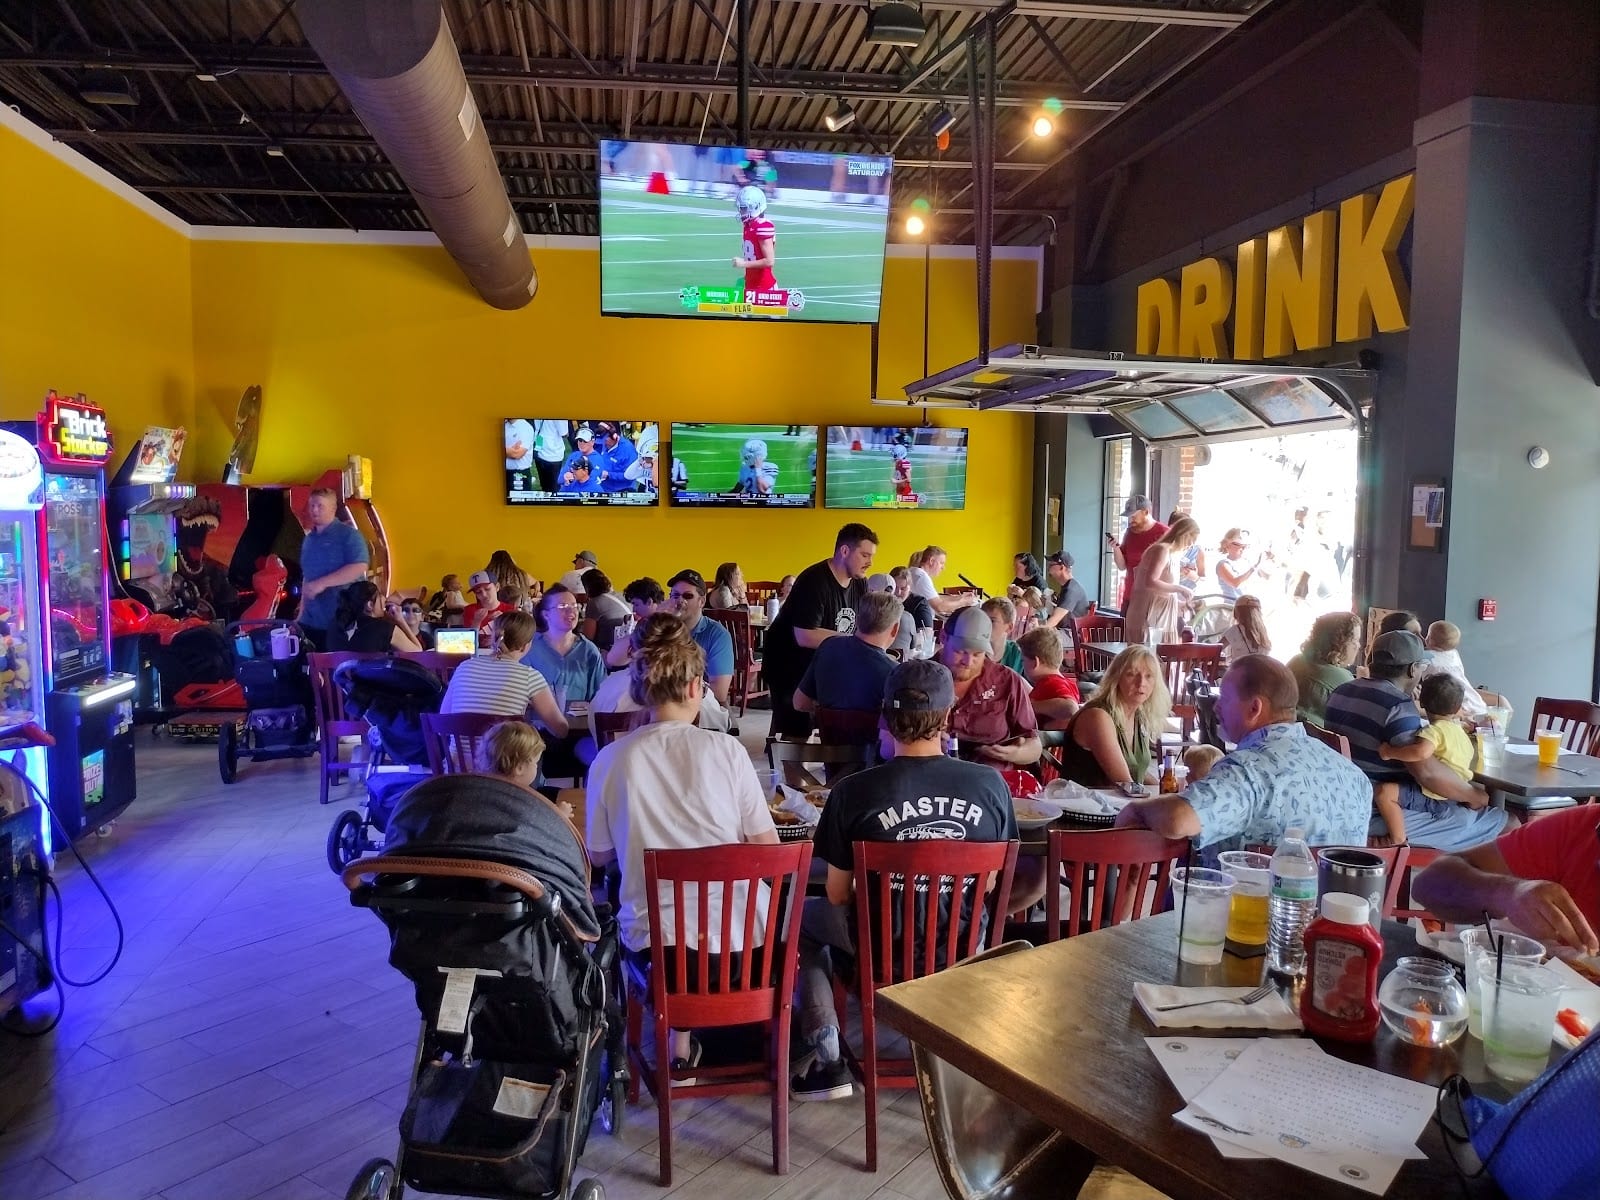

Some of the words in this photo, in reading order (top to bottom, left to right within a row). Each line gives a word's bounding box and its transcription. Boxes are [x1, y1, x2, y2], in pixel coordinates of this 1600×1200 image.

[1136, 173, 1415, 361] DRINK
[745, 291, 756, 304] 21
[734, 305, 752, 313] FLAG
[59, 408, 107, 438] Brick
[472, 574, 480, 584] T
[83, 764, 101, 780] PRIZE
[877, 796, 983, 831] MASTER
